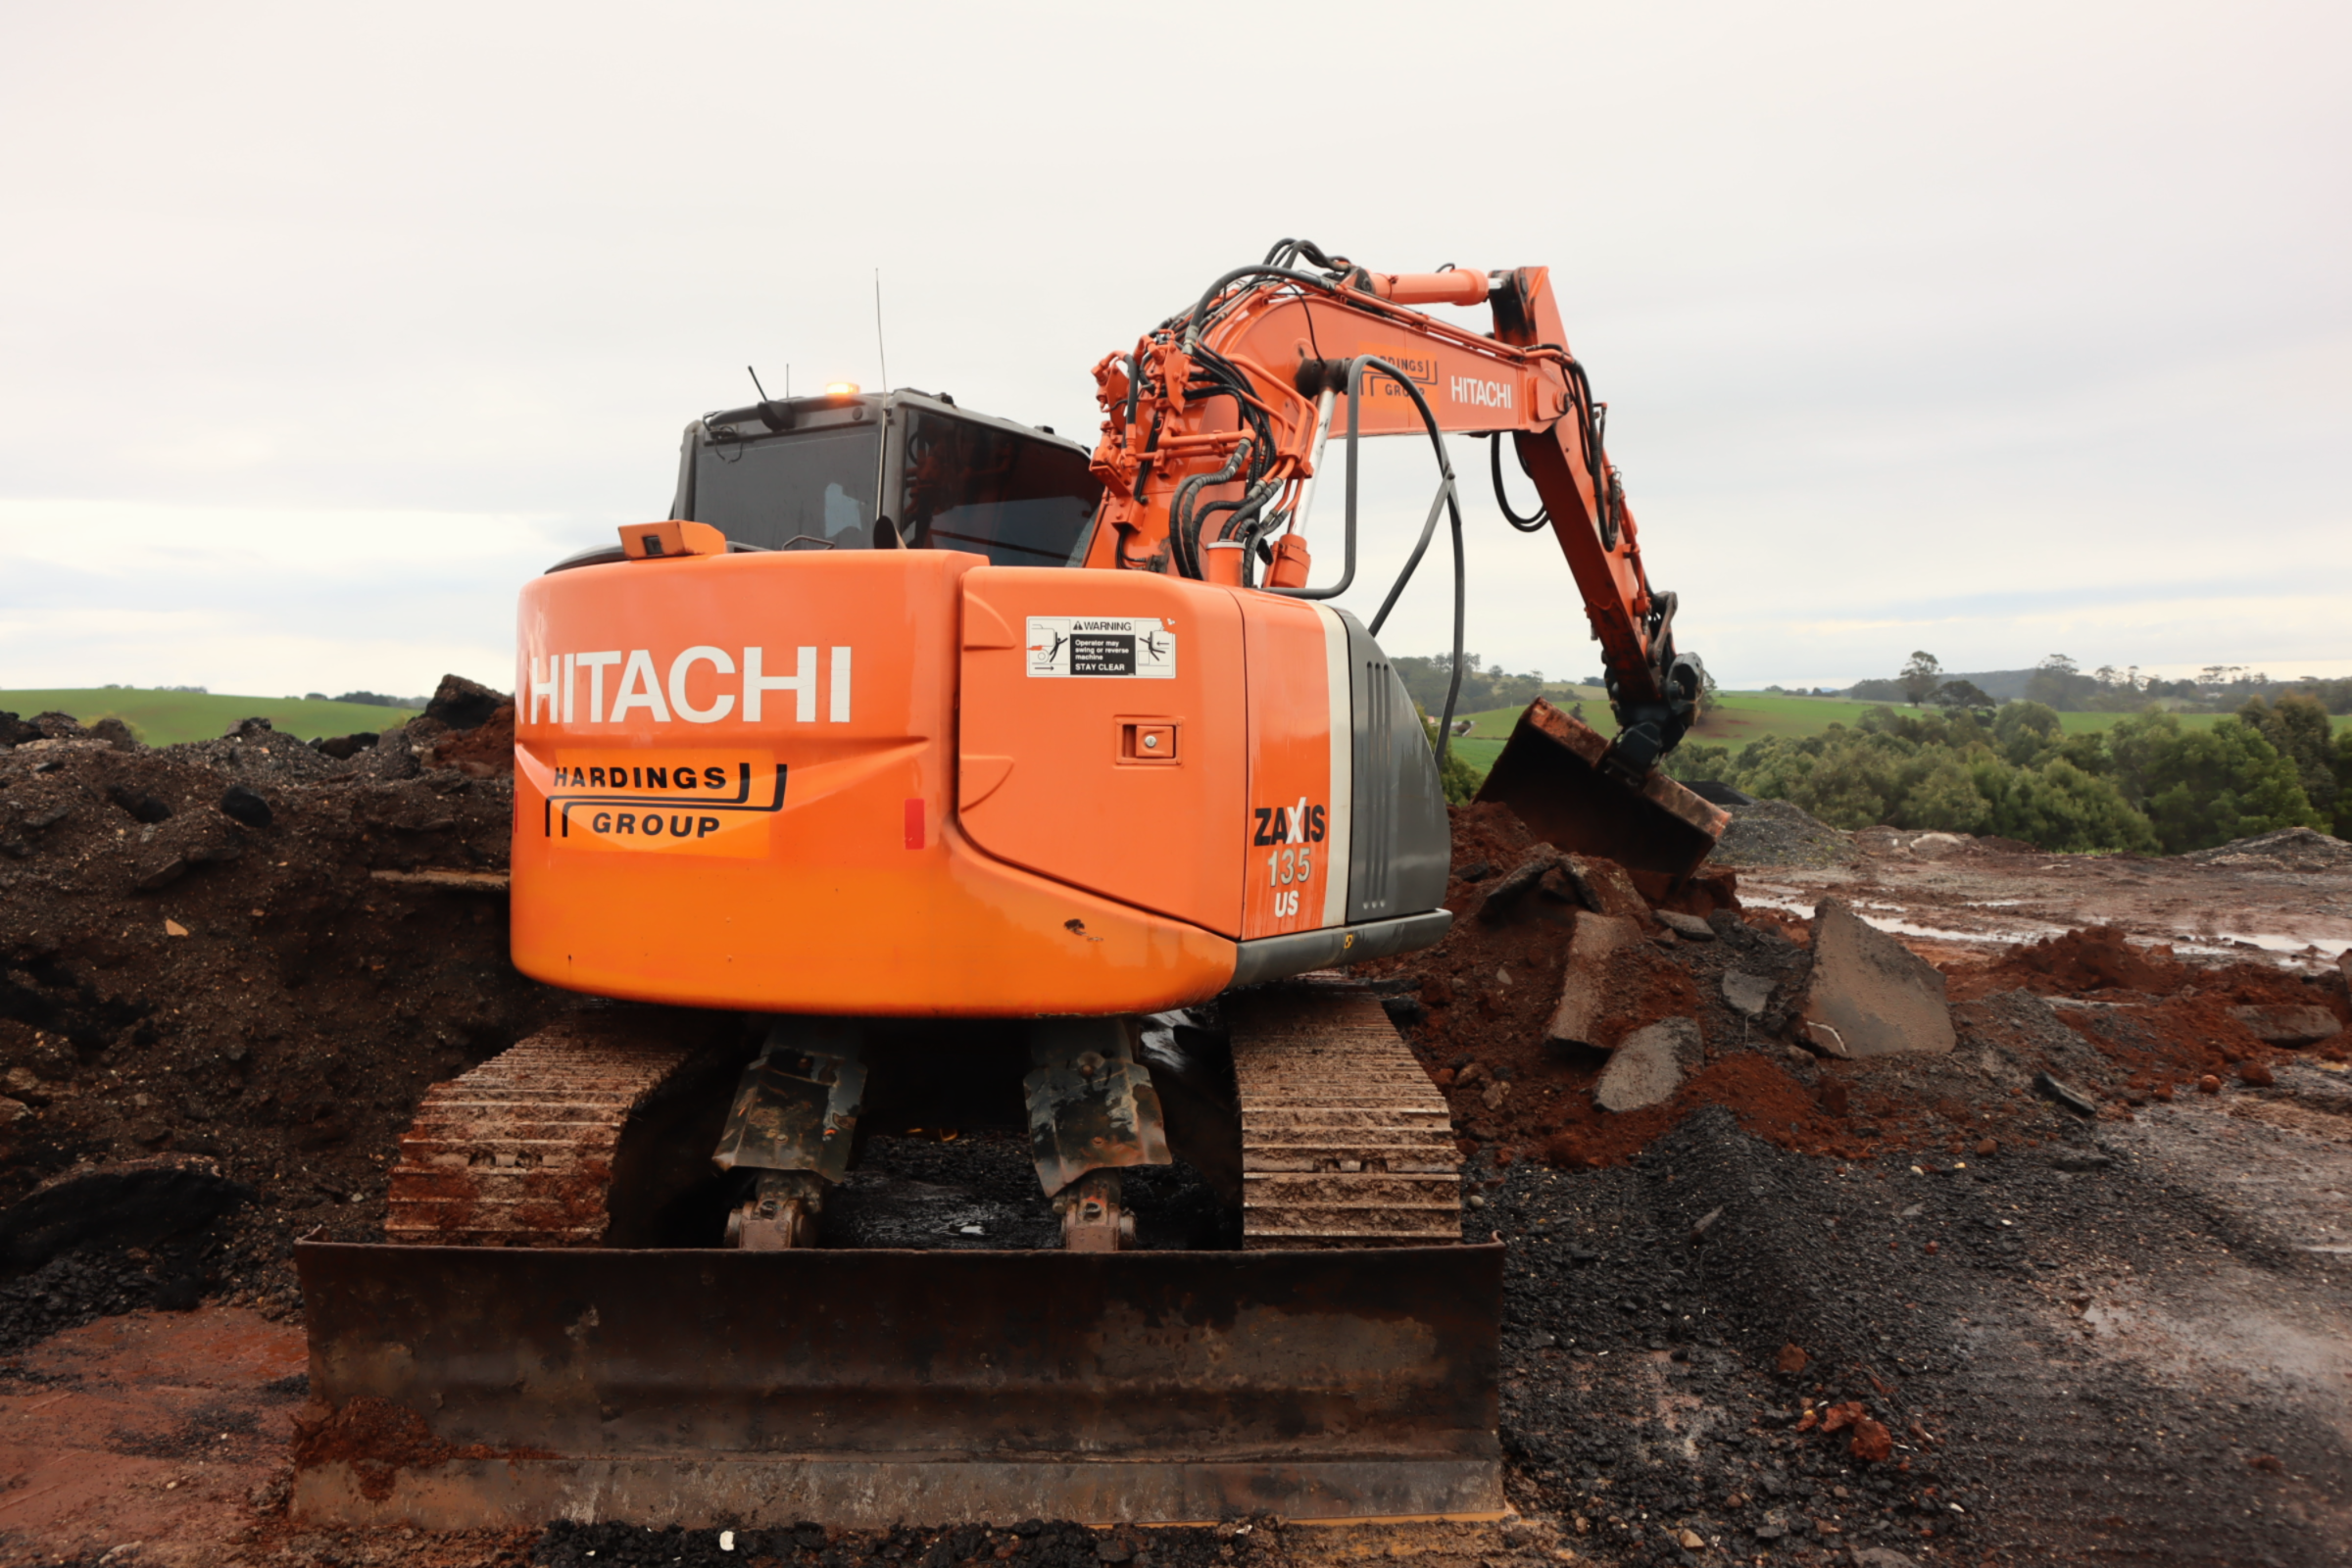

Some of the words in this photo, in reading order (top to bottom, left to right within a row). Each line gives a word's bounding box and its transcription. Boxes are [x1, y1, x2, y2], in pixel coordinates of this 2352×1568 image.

[1385, 383, 1425, 397] GROP
[1450, 375, 1512, 409] HITACHI
[1084, 621, 1132, 631] WARNING
[530, 646, 852, 724] HITACHI
[554, 766, 727, 790] HARDINGS
[592, 812, 720, 838] GROUP
[1253, 797, 1326, 847] ZAXIS
[1267, 848, 1311, 887] 135
[1274, 890, 1299, 917] US
